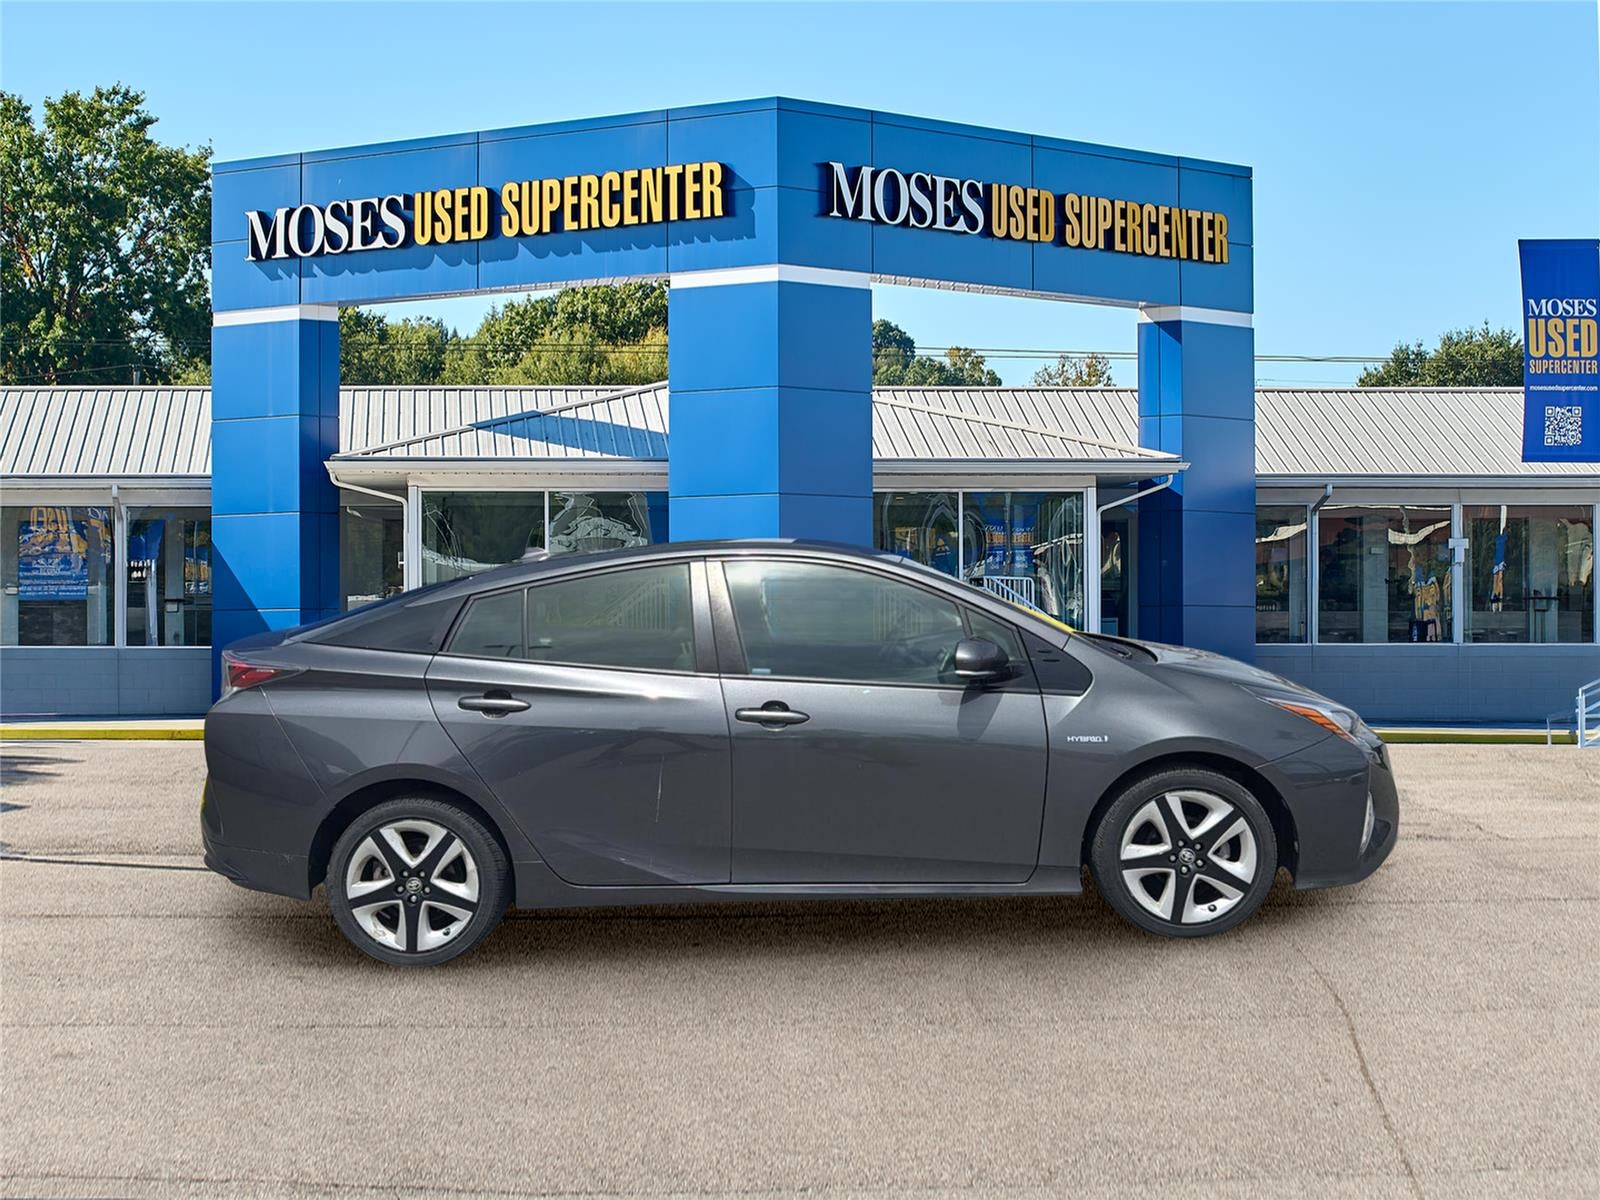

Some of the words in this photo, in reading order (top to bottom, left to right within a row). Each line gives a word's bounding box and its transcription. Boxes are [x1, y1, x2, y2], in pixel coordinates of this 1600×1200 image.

[244, 194, 407, 262] MOSES
[413, 186, 489, 246] USED
[501, 161, 724, 238] SUPERCENTER
[829, 161, 985, 235] MOSES
[991, 183, 1056, 243] USED
[1065, 193, 1230, 264] SUPERCENTER
[1527, 298, 1597, 317] MOSES
[1528, 318, 1598, 358] USED
[1529, 359, 1598, 375] SUPERCENTER
[1529, 384, 1598, 392] mosesusedsupercenter.com
